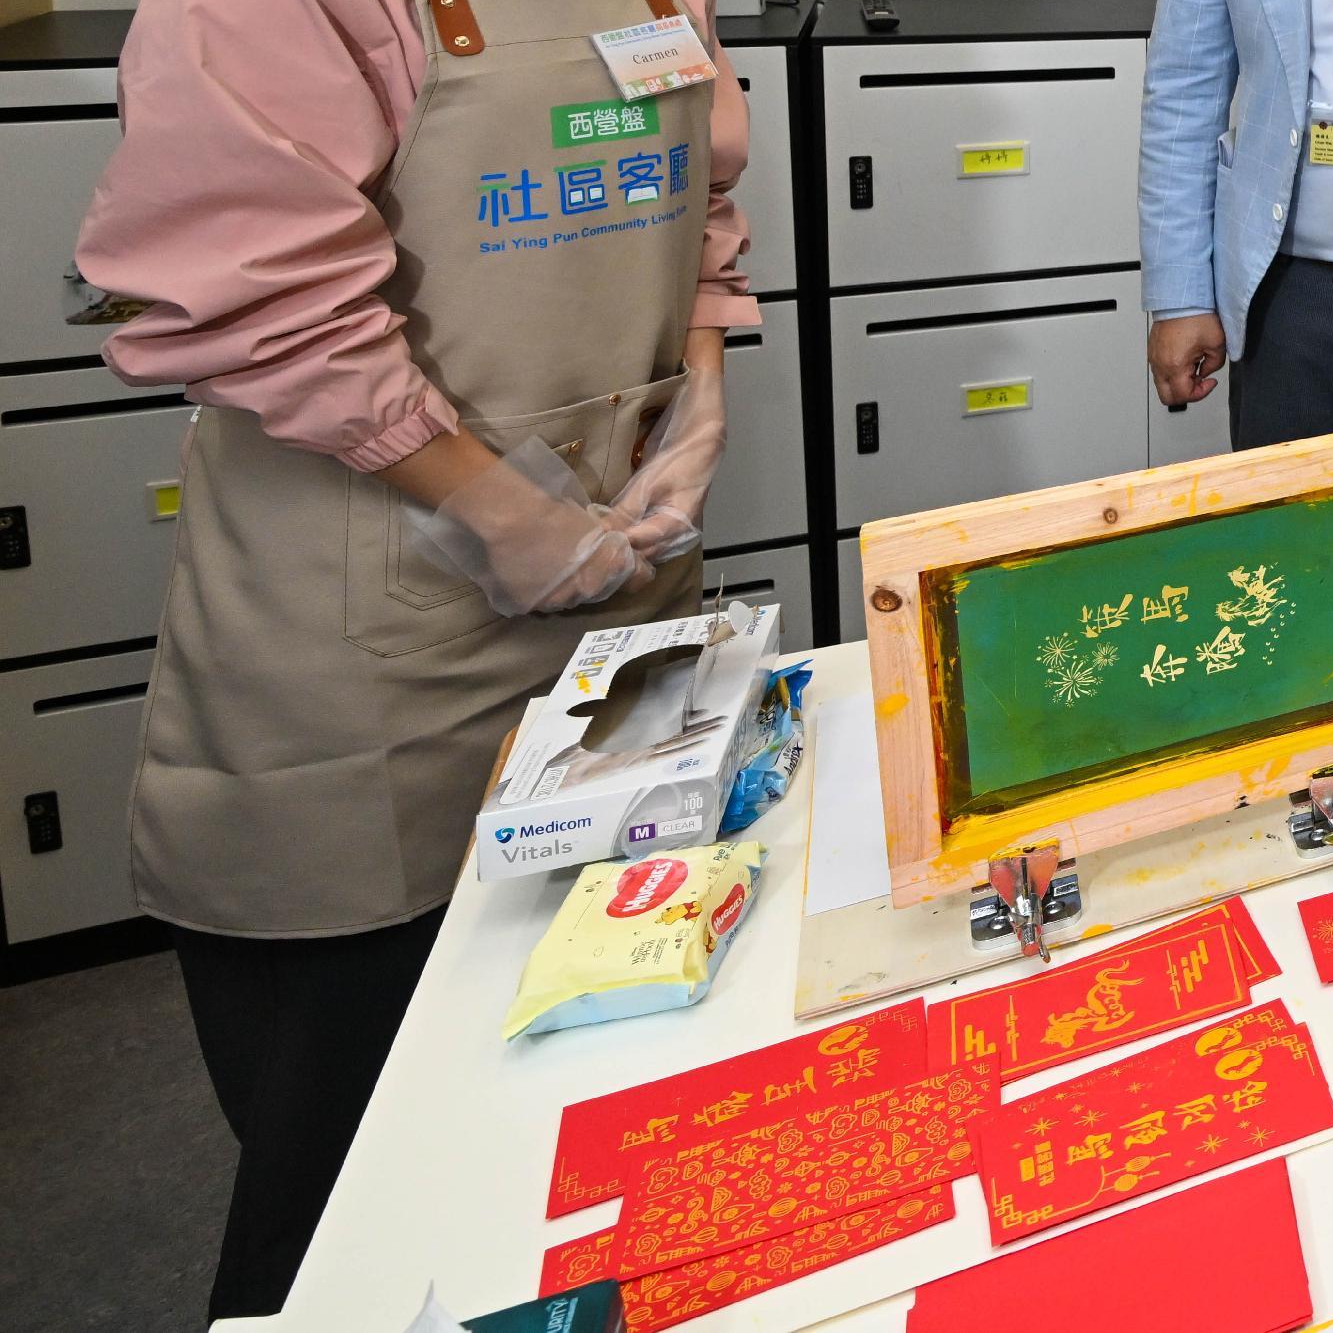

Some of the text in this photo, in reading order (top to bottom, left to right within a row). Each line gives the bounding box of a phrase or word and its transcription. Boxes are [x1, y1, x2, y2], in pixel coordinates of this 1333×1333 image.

[632, 47, 678, 65] Carmen
[568, 106, 646, 139] 西營盤
[476, 143, 689, 227] 社區客廳
[480, 241, 506, 254] Sai
[512, 235, 548, 250] Ying
[553, 231, 578, 244] Pun
[581, 217, 648, 238] Community
[684, 796, 703, 811] 100
[520, 817, 593, 839] Medicom
[635, 820, 695, 840] M CLEAR
[501, 839, 573, 864] Vitals
[622, 861, 673, 913] HUGGIES
[713, 895, 744, 932] HUGGIES
